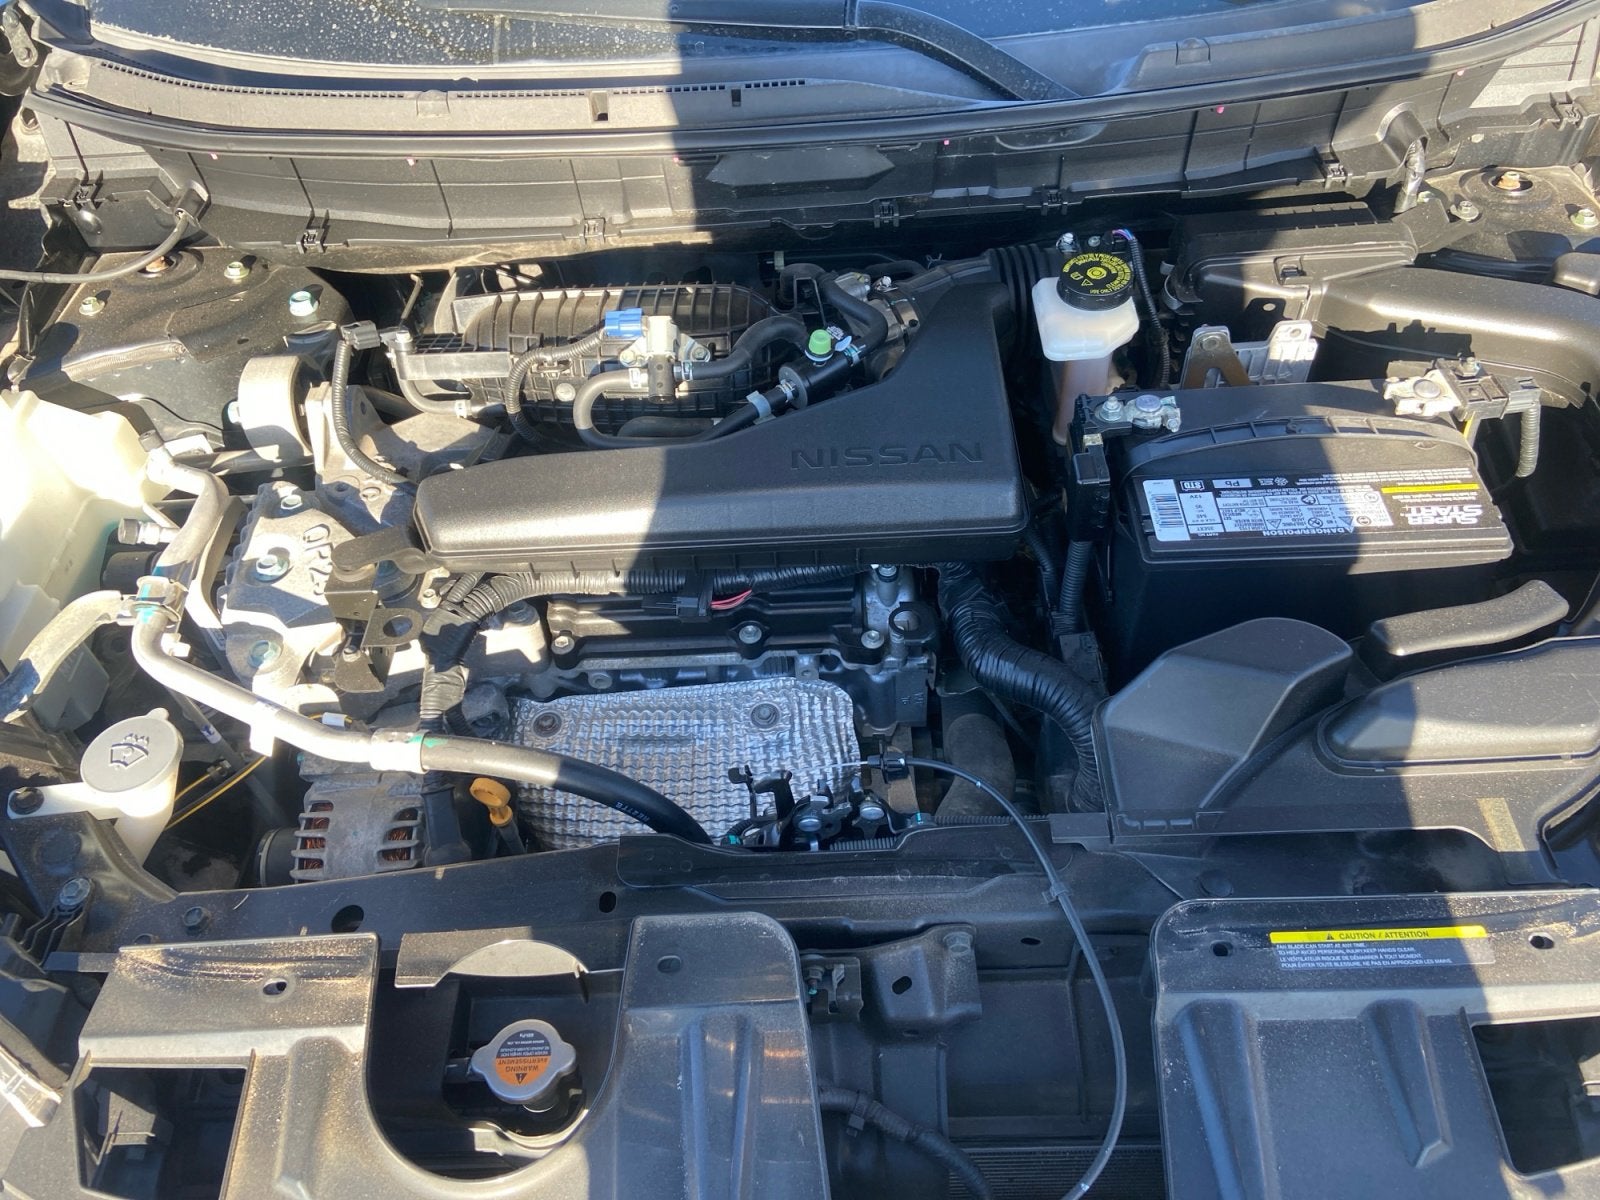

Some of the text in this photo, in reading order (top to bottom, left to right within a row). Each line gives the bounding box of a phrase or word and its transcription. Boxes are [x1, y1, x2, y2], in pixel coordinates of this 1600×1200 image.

[790, 442, 984, 470] NISSAN
[1409, 504, 1483, 516] START
[1408, 516, 1478, 525] SUPER
[1262, 528, 1345, 536] DANGER/POISON
[1339, 932, 1375, 940] CAUTION
